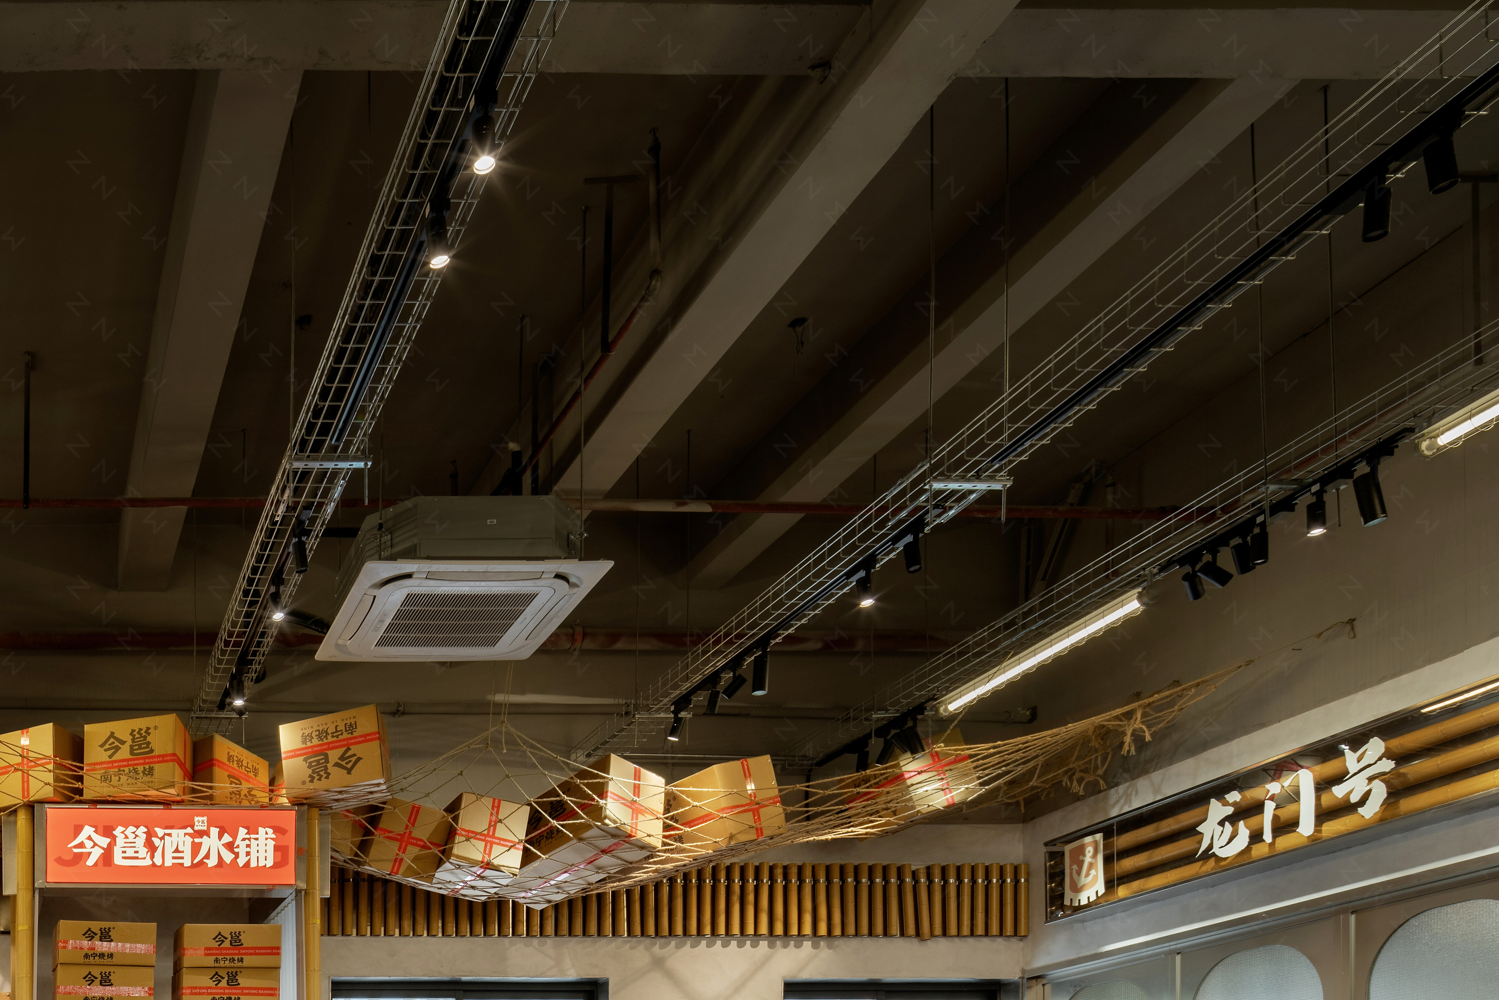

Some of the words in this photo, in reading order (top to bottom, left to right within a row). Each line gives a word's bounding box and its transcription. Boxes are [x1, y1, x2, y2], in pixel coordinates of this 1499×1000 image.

[300, 721, 358, 746] 南宁烧烤
[98, 726, 155, 760] 今邕
[302, 746, 364, 784] 今邕
[1195, 736, 1397, 859] 龙门号
[67, 824, 277, 868] 今邕酒水铺
[81, 927, 114, 943] 今邕
[212, 931, 244, 947] 今邕
[83, 952, 114, 960] 南宁烧烤
[213, 957, 244, 965] 南宁烧烤
[82, 971, 114, 987] 今邕
[209, 971, 241, 987] 今邕
